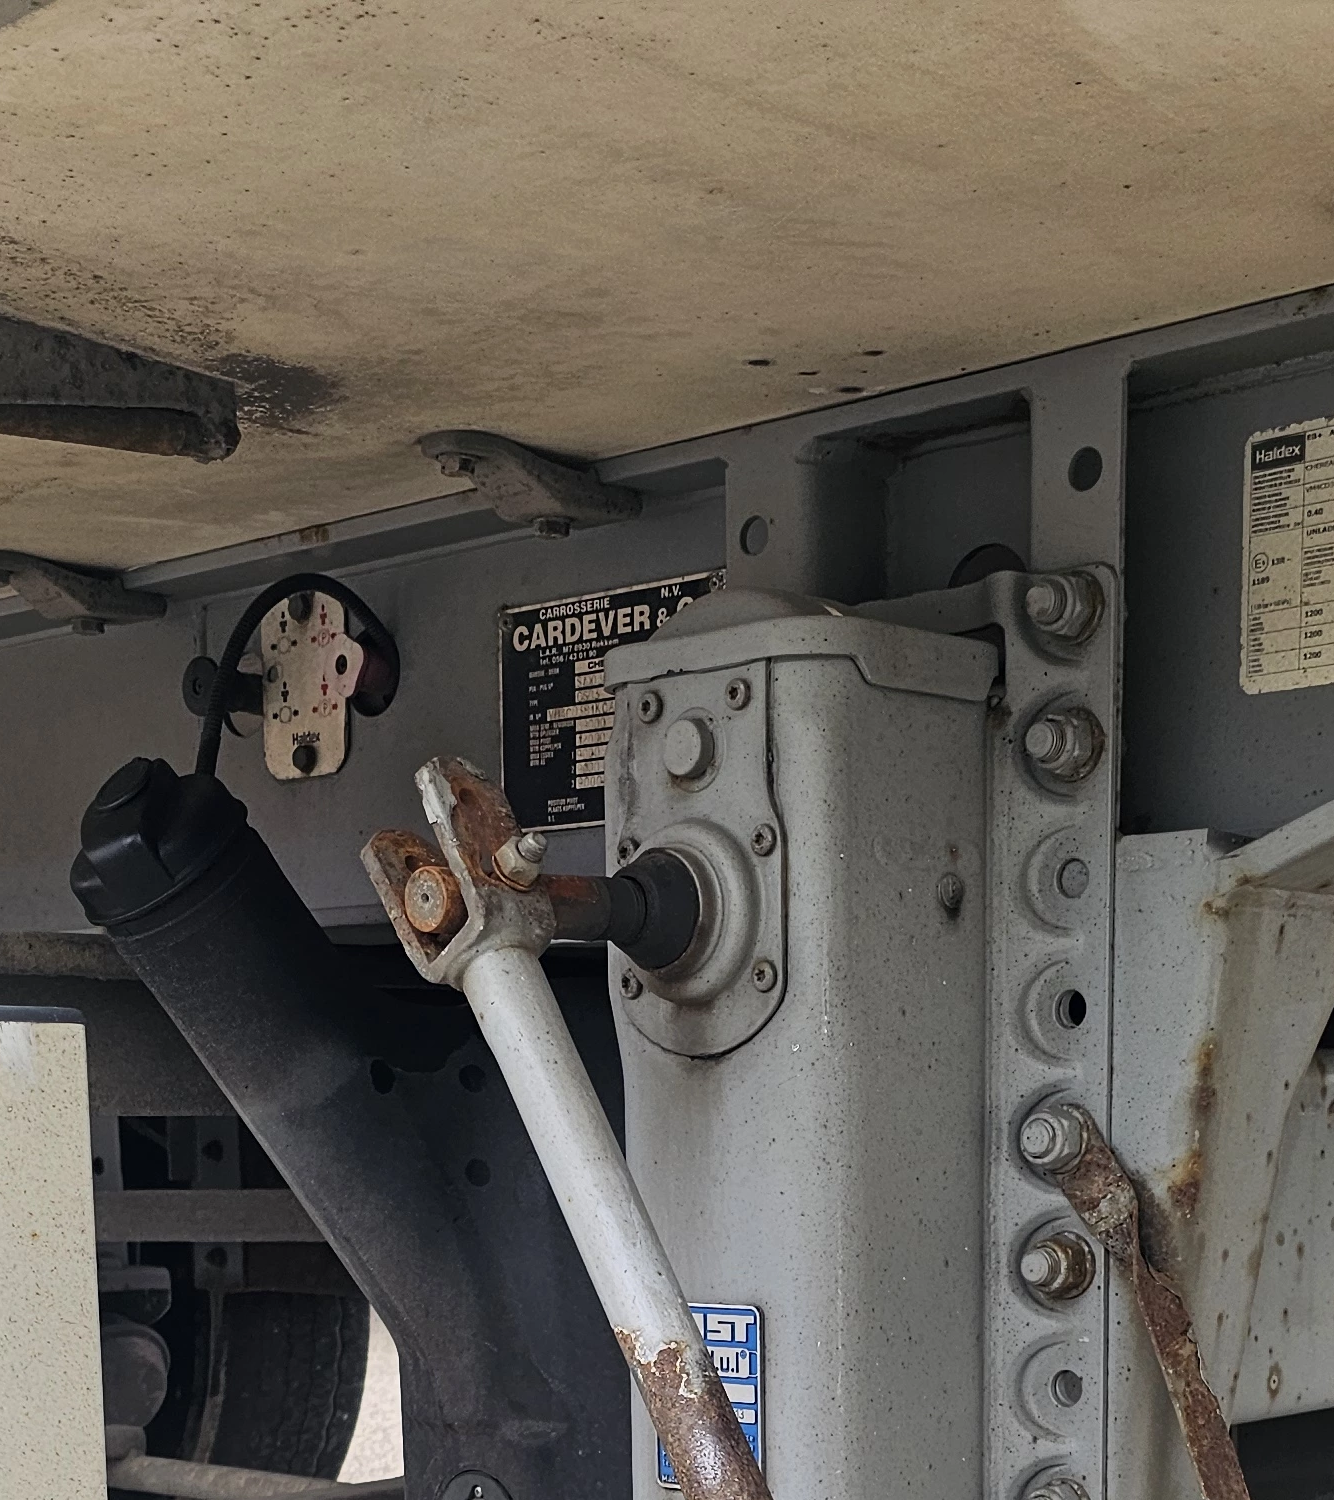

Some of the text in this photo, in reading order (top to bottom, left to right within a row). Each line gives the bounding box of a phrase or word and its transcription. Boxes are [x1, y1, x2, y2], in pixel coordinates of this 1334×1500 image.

[1255, 444, 1301, 464] Haldex
[1306, 508, 1324, 517] 0.40
[539, 585, 681, 620] CARROSSERIE N.V.
[1305, 609, 1323, 618] 1200
[513, 604, 650, 651] CARDEVER
[1304, 630, 1323, 639] 1200
[539, 646, 559, 657] L.A.R.
[569, 652, 577, 661] 43
[1303, 651, 1322, 660] 1200
[292, 730, 321, 747] Haldex
